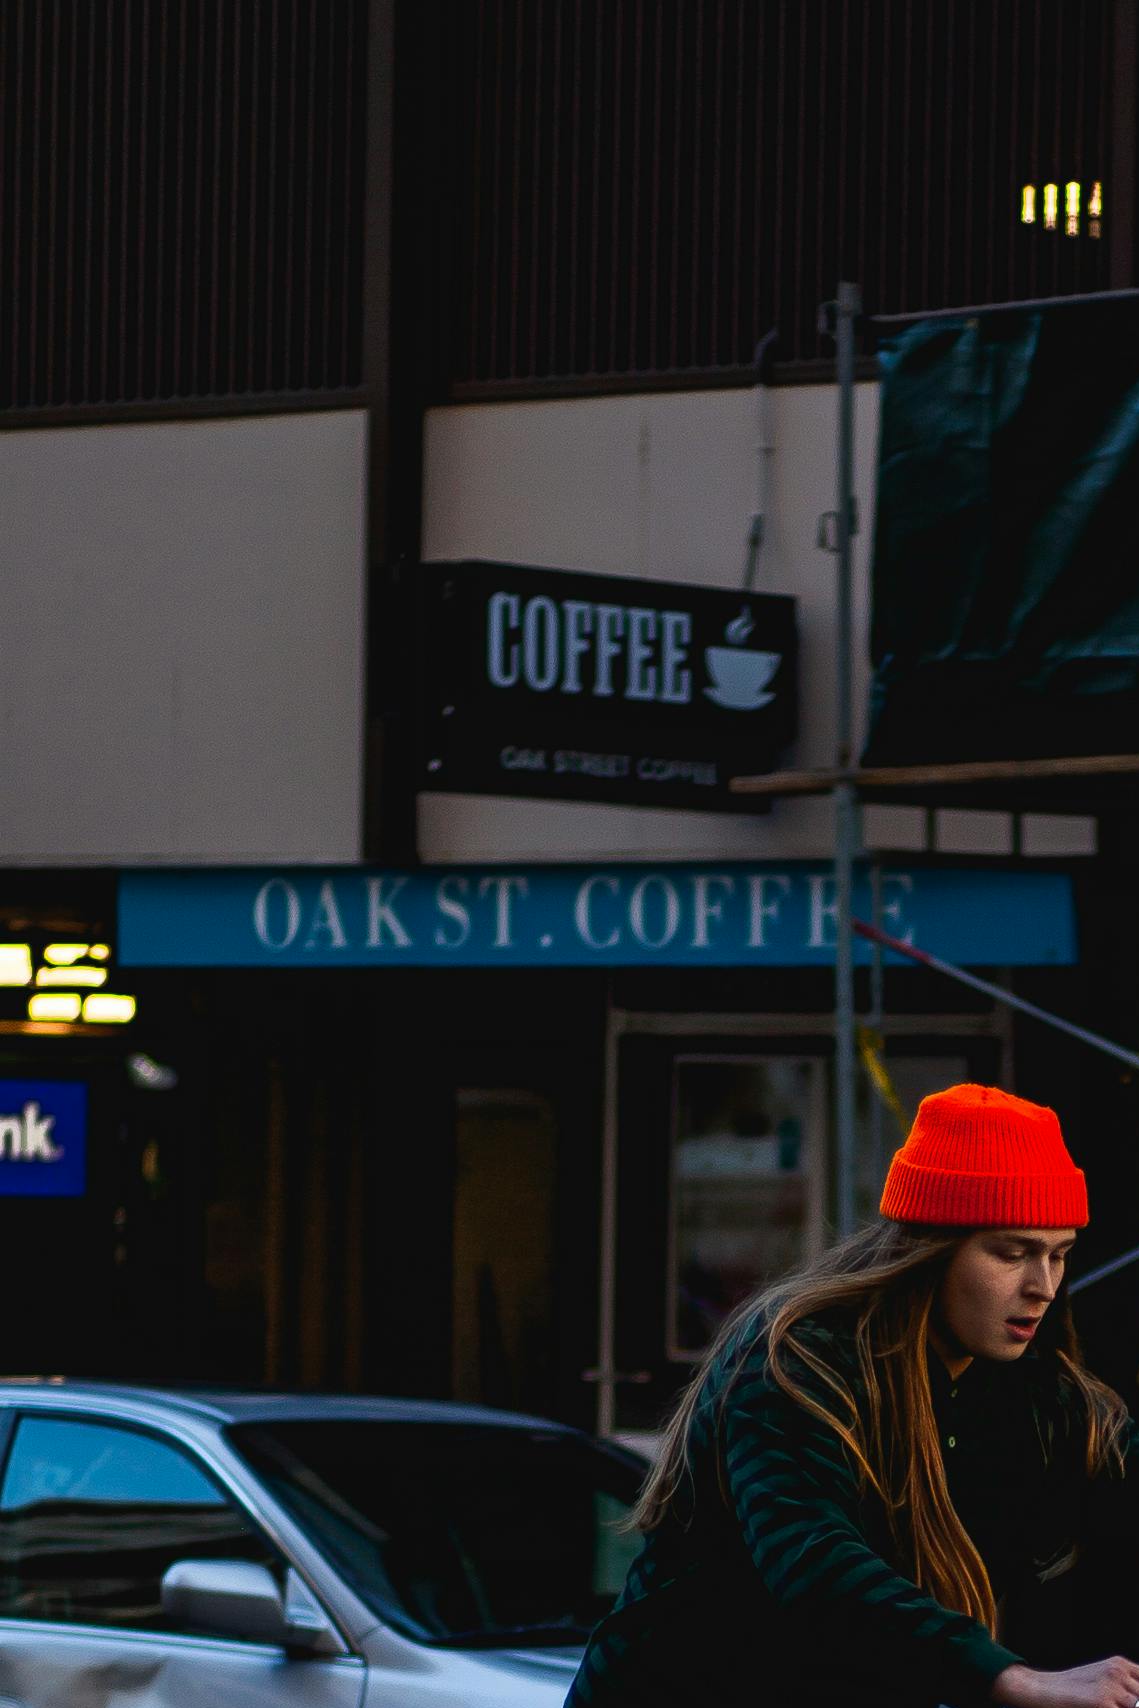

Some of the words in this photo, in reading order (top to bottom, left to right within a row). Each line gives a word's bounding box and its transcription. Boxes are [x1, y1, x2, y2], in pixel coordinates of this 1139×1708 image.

[486, 591, 693, 704] COFFEE
[252, 876, 413, 949] OAK
[434, 874, 555, 949] ST.
